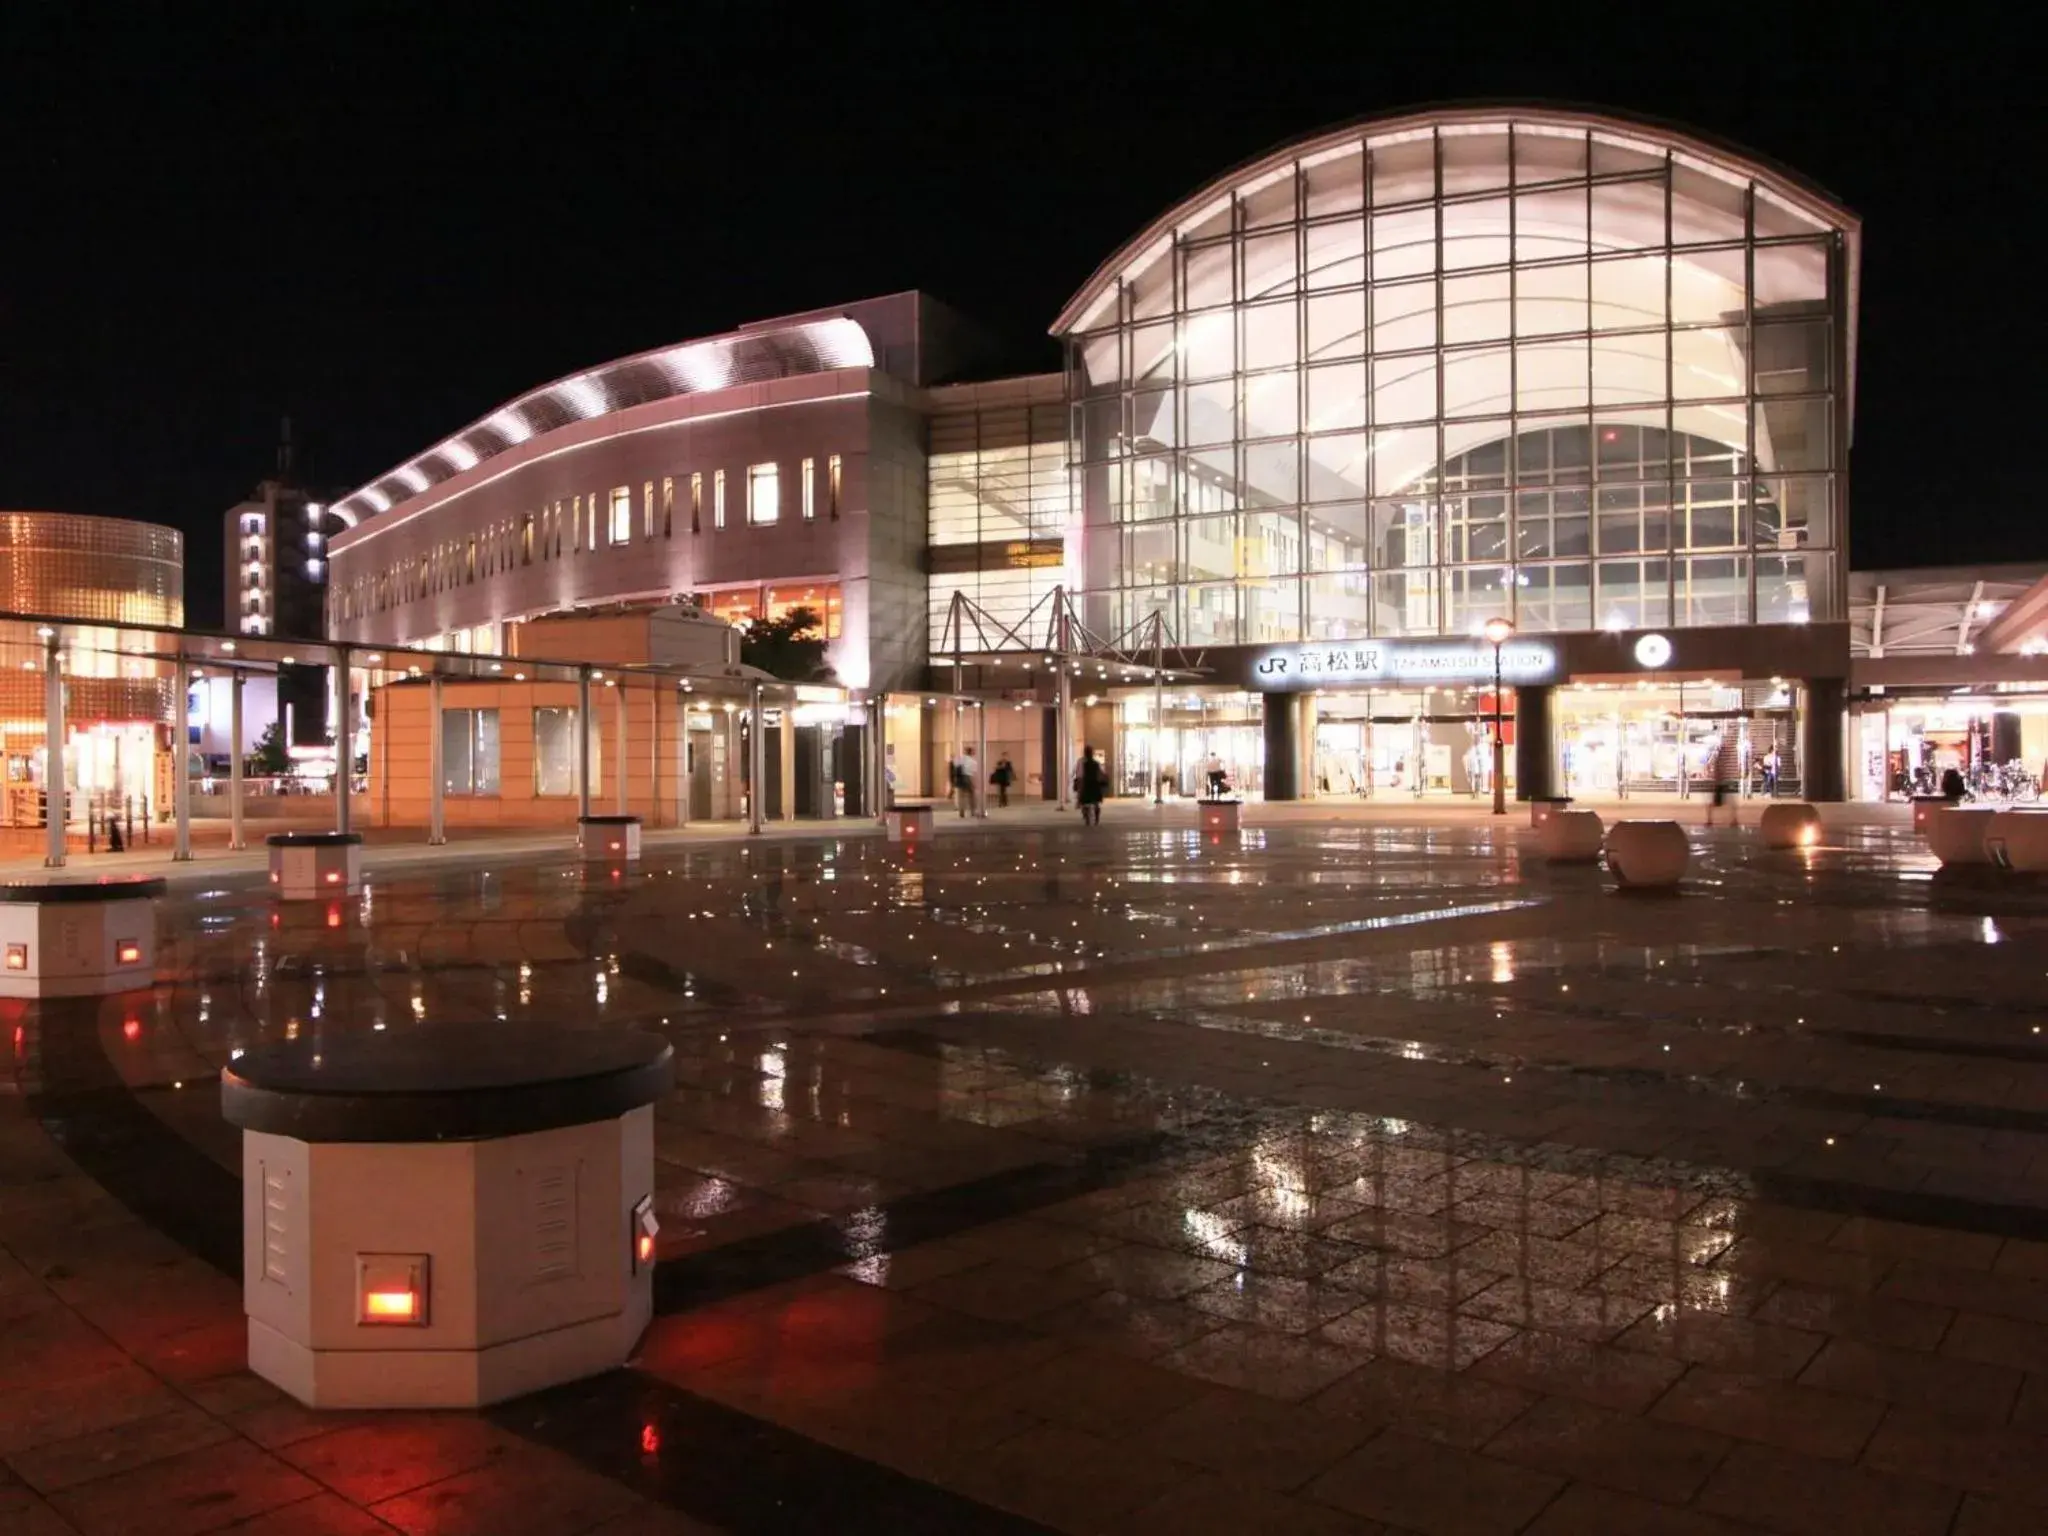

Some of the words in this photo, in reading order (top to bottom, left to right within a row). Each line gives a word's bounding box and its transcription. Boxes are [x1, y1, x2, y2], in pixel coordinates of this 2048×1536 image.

[1259, 658, 1288, 674] JR
[1299, 650, 1378, 674] 高松駅
[1481, 654, 1545, 670] SATION
